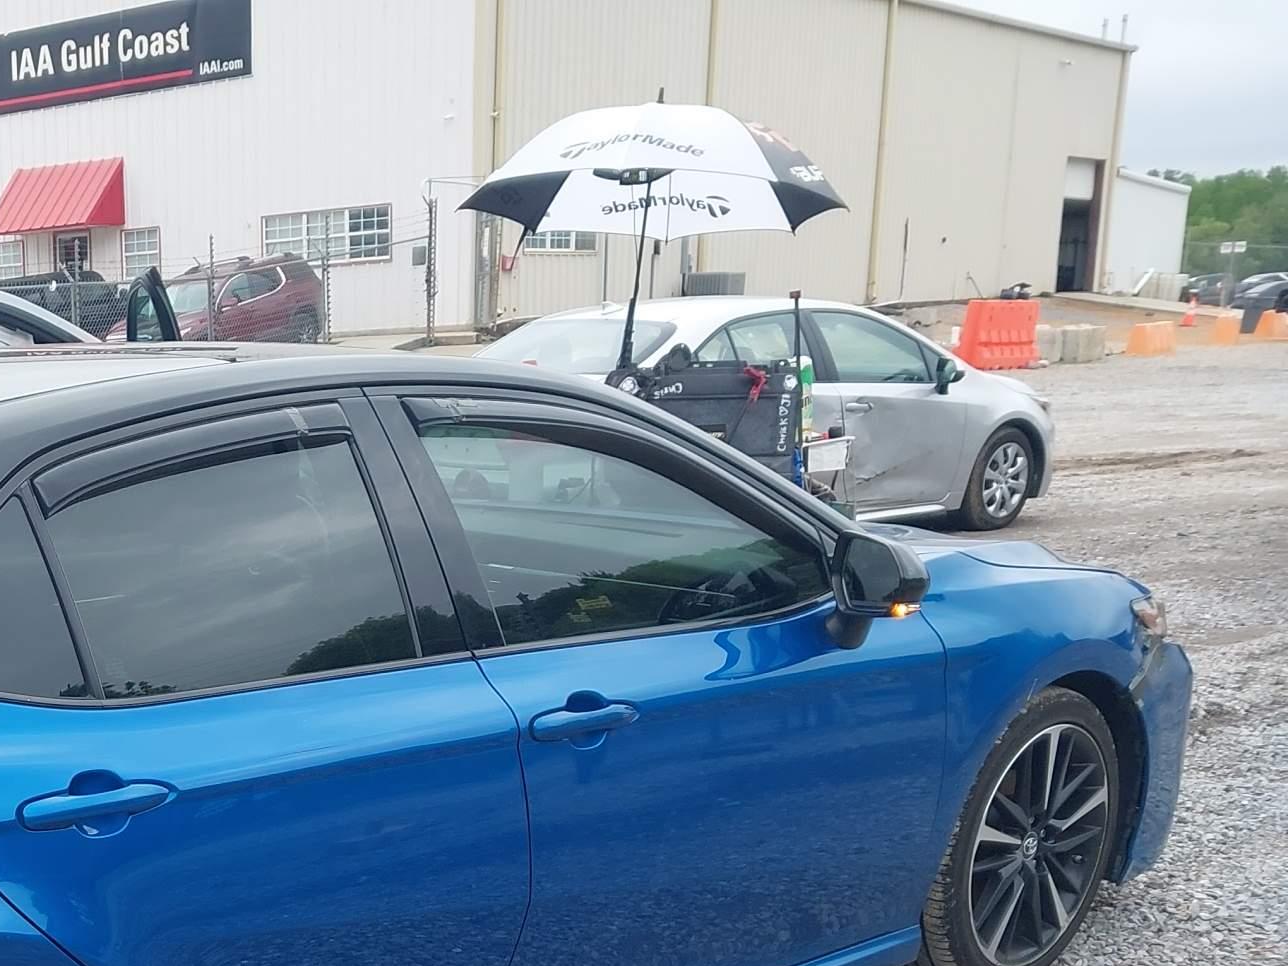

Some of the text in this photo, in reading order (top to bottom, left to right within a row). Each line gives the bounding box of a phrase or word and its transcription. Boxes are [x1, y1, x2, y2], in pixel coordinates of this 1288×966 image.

[11, 21, 191, 81] IAA Gulf Coast
[199, 58, 244, 75] IAAI.com
[560, 134, 704, 159] TaylorMade
